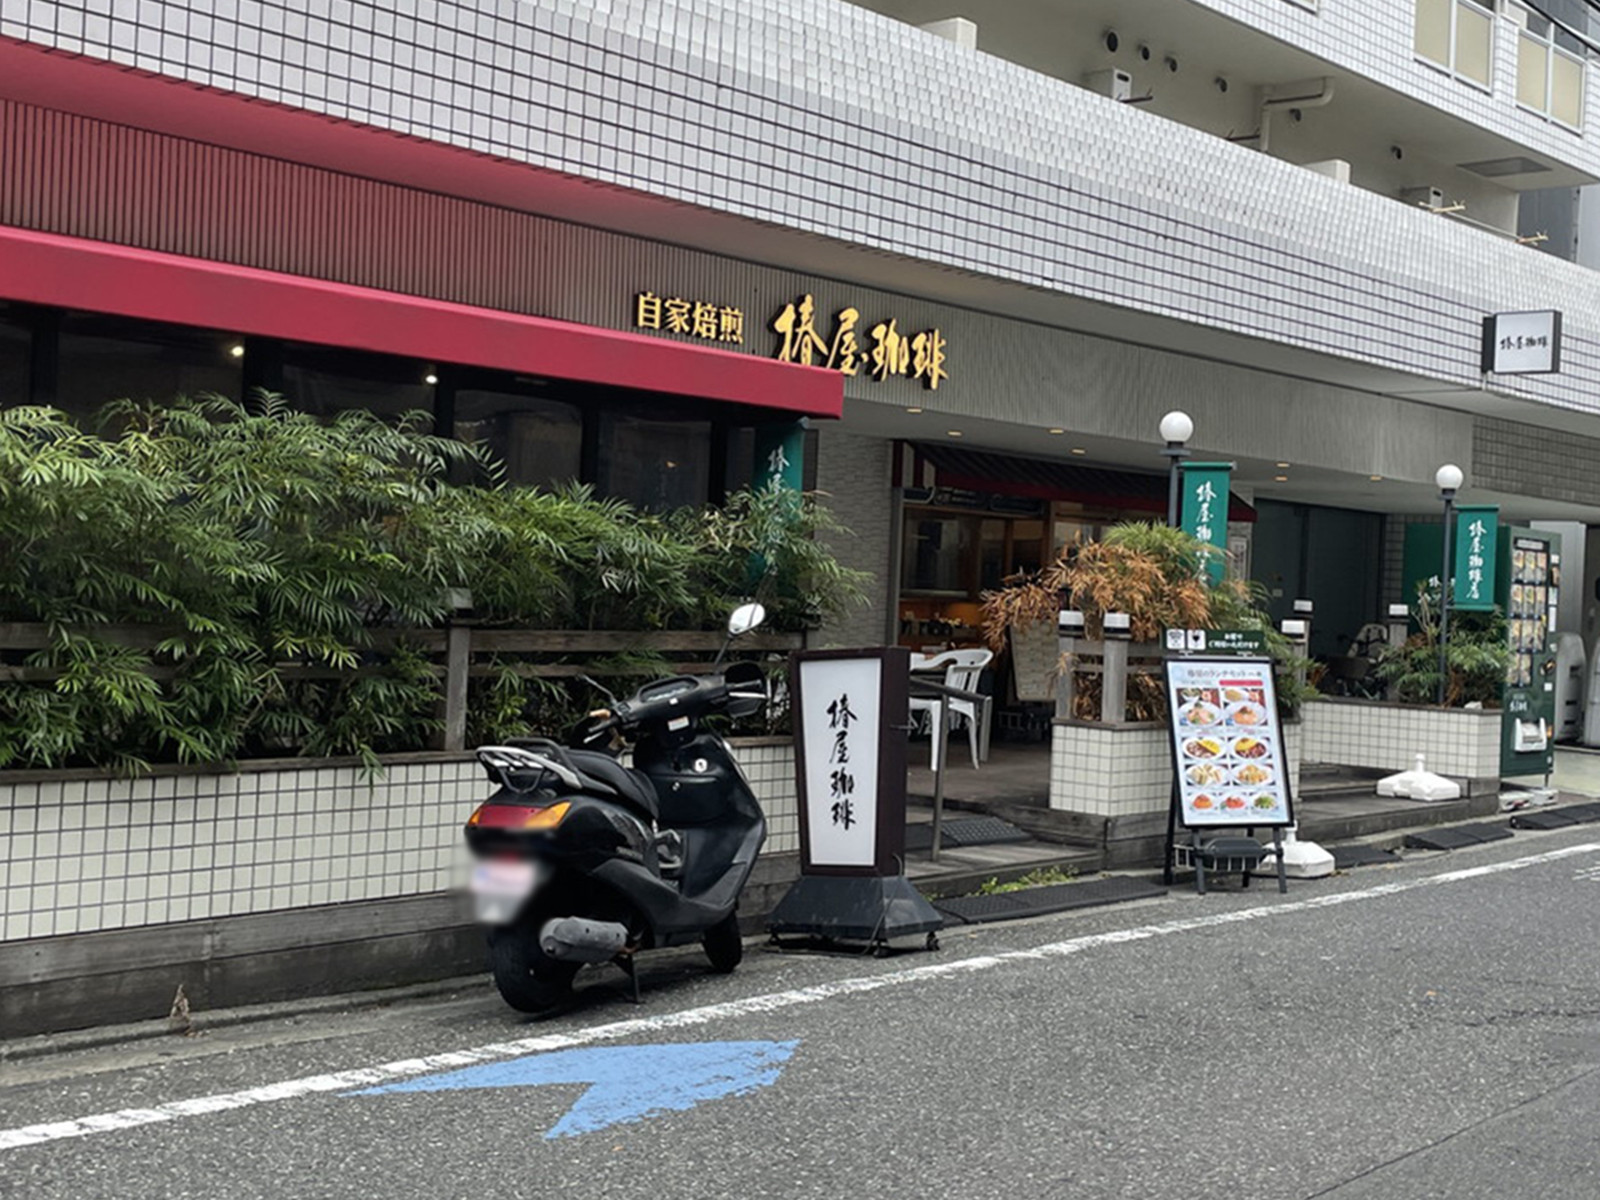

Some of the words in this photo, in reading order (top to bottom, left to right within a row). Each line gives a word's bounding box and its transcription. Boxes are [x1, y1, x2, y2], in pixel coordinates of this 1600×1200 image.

[637, 292, 744, 343] 自家焙煎
[773, 293, 948, 389] 椿屋珈琲
[1466, 519, 1487, 599] 椿屋珈琲店
[827, 693, 857, 831] 椿屋珈琲
